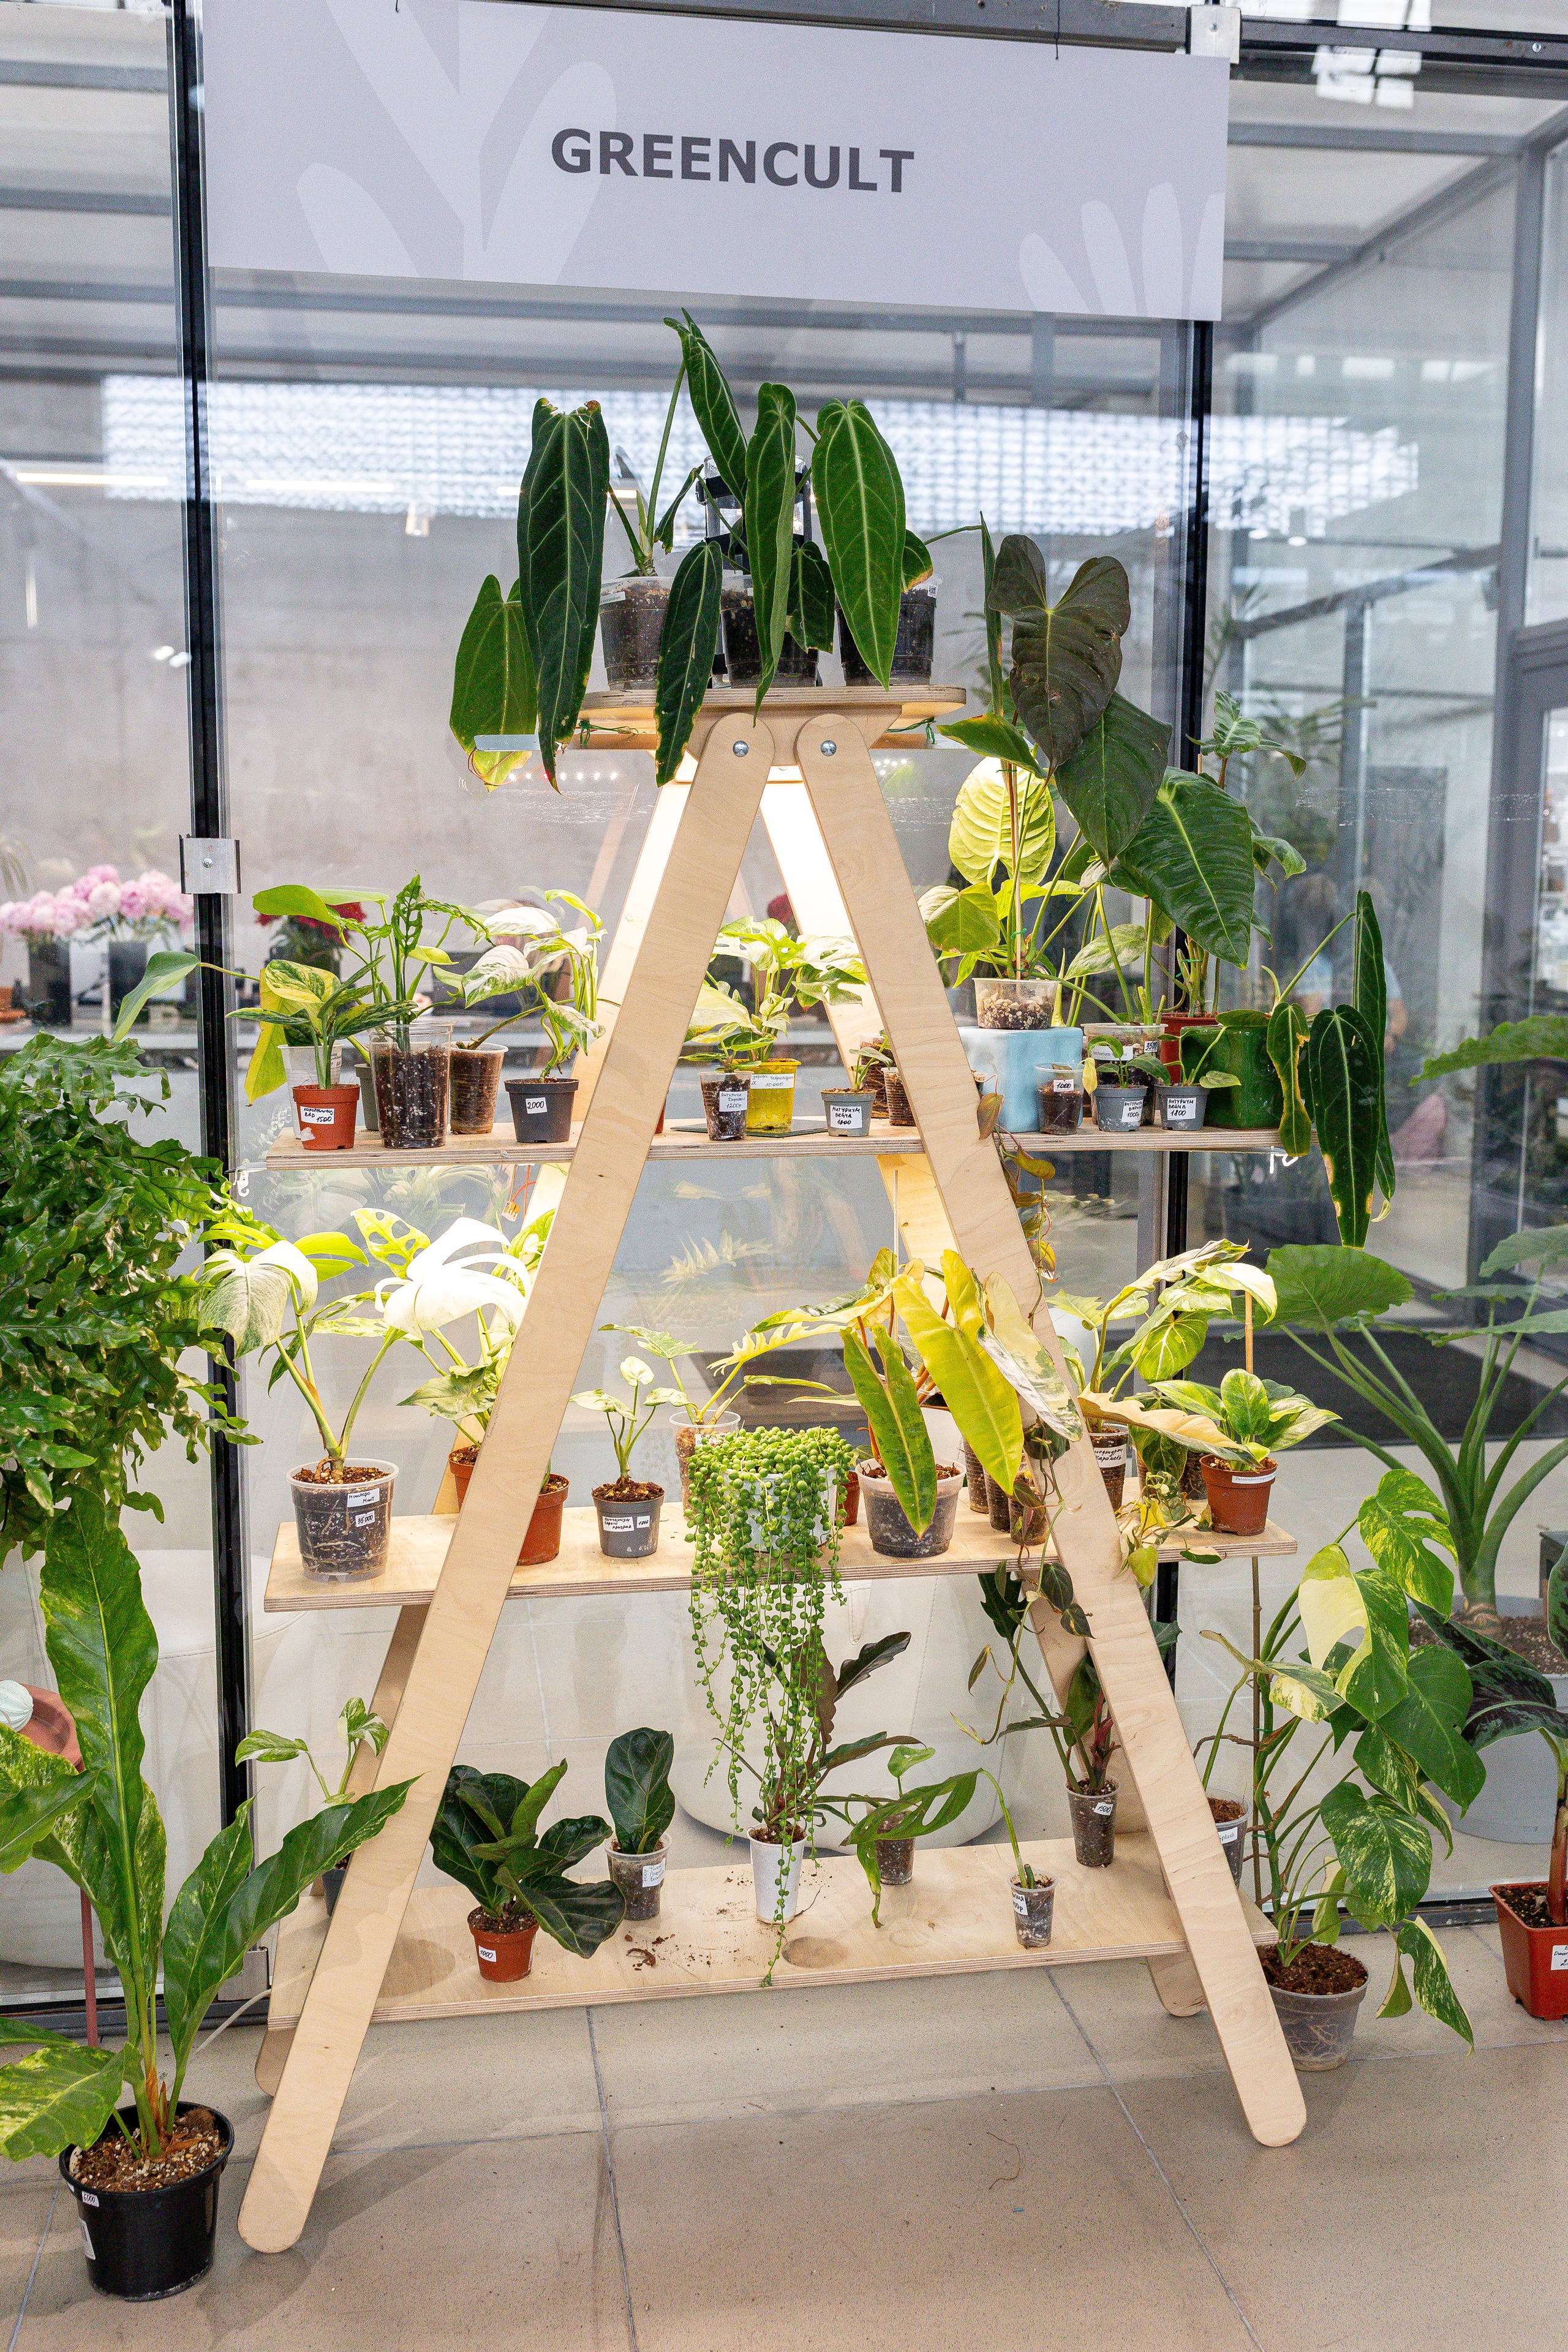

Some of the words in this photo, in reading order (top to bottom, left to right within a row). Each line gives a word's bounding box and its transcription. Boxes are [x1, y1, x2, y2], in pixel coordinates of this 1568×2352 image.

[551, 128, 914, 193] GREENCULT
[527, 1101, 544, 1109] 2000
[480, 1950, 494, 1959] 1000
